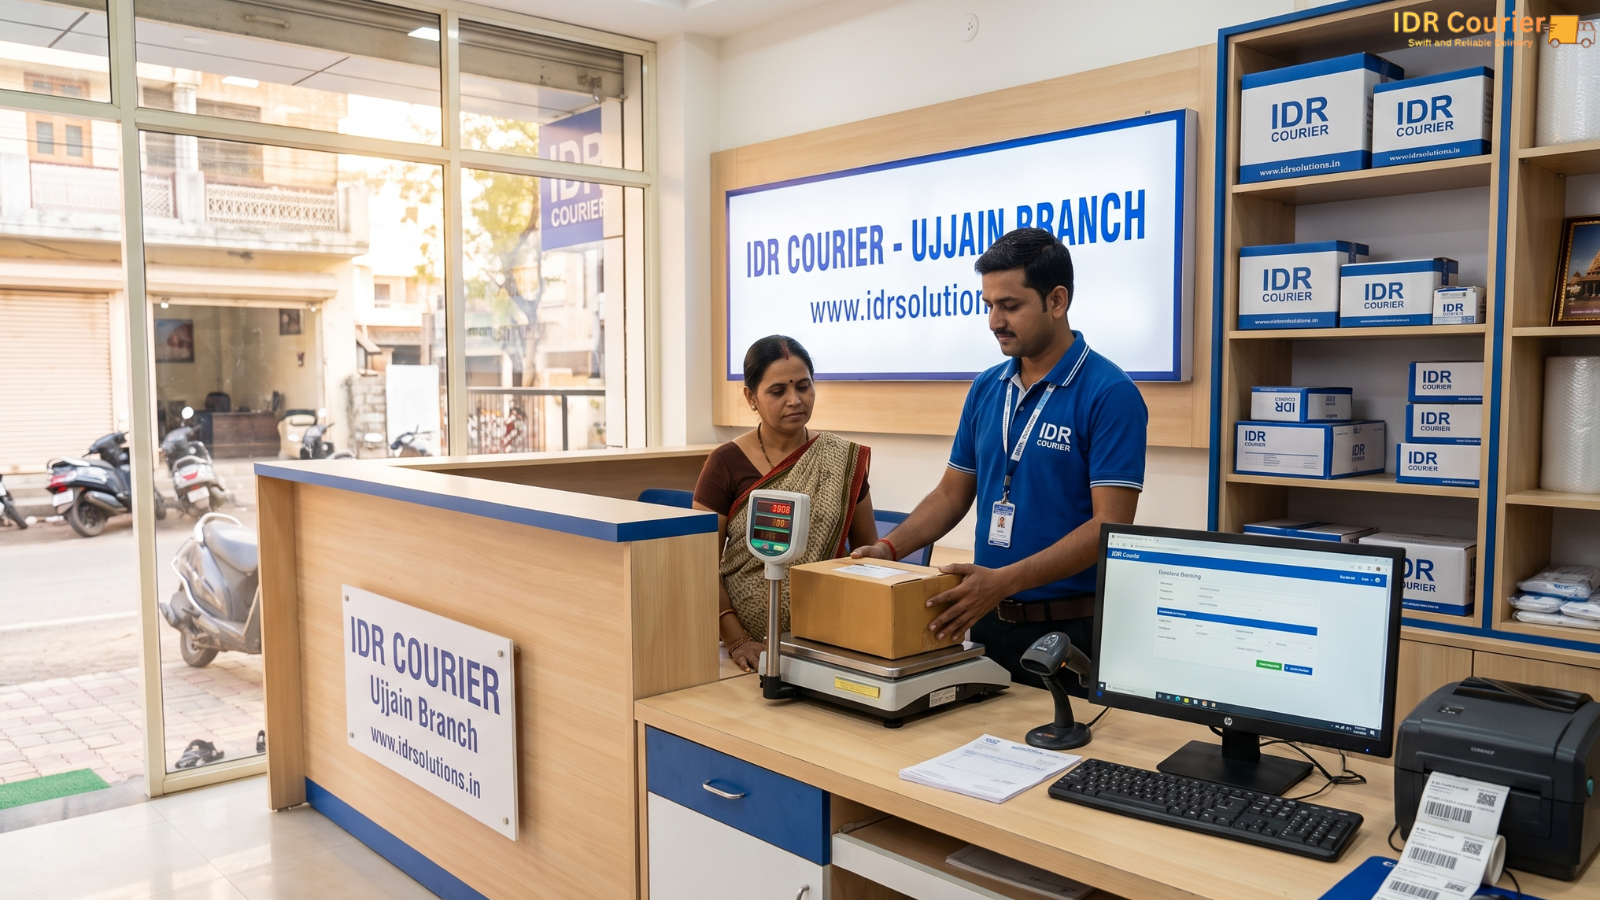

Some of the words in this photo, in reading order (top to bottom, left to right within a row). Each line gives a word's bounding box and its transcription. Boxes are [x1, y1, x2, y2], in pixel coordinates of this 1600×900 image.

[1271, 96, 1329, 130] IDR
[1397, 95, 1454, 126] IDR
[1271, 124, 1329, 143] COURIER
[1396, 120, 1454, 138] COURIER
[1259, 160, 1341, 177] www.idrsolutions.in
[747, 238, 780, 278] IDR
[787, 224, 884, 274] COURIER
[912, 208, 1004, 262] UJJAIN
[1263, 266, 1313, 292] IDR
[1262, 291, 1313, 303] COURIER
[1364, 281, 1404, 301] IDR
[810, 283, 988, 324] www.idrsolution
[1363, 300, 1404, 310] COURIER
[1442, 303, 1464, 312] IDR
[1422, 370, 1452, 384] IDR
[1275, 402, 1295, 413] IDR
[1420, 411, 1451, 425] IDR
[1039, 422, 1072, 444] IDR
[1244, 430, 1266, 442] IDR
[1036, 439, 1071, 452] COURIER
[1352, 443, 1366, 457] IDR
[1408, 451, 1438, 465] IDR
[1403, 557, 1435, 582] DR
[1402, 581, 1436, 593] OURIER
[350, 615, 386, 666] IDR
[392, 631, 501, 715] COURIER
[370, 674, 413, 721] Ujjain
[418, 696, 478, 754] Branch
[370, 726, 481, 799] www.idrsolutions.in
